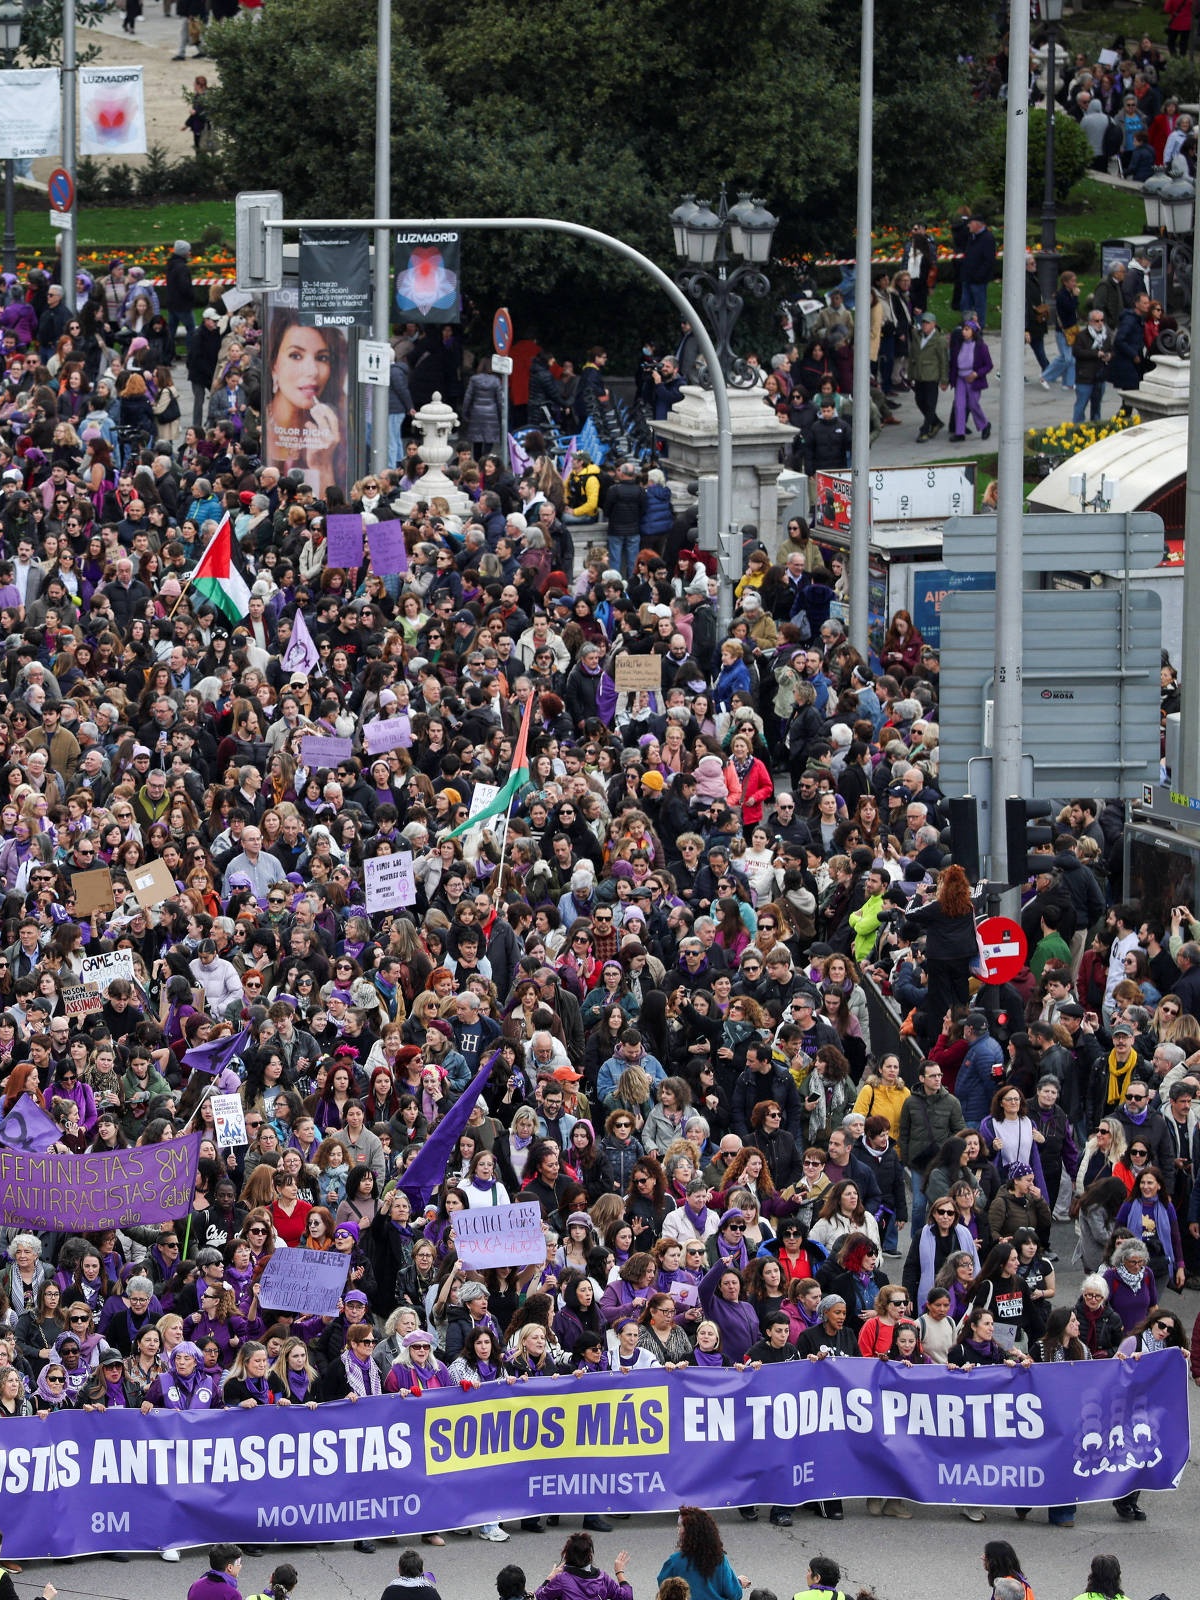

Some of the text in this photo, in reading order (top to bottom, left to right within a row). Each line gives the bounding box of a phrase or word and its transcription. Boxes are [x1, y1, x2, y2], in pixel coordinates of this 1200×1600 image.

[82, 74, 139, 84] LUZMADRID
[397, 232, 459, 244] LUZMADRID
[324, 316, 355, 325] MADRID
[82, 953, 114, 972] GAME
[71, 986, 86, 996] SON
[65, 996, 103, 1014] ASESINATOS
[0, 1145, 190, 1185] FEMINISTAS 8M
[2, 1181, 157, 1214] ANTIRRACISTAS
[3, 1208, 25, 1226] Nos
[53, 1215, 65, 1231] la
[98, 1216, 115, 1229] en
[119, 1208, 142, 1225] ello
[457, 1235, 542, 1255] EDUCA HIJOS
[90, 1422, 412, 1484] ANTIFASCISTAS
[429, 1407, 565, 1463] SOMOS
[576, 1393, 664, 1446] MÁS
[683, 1396, 736, 1442] EN
[746, 1387, 874, 1440] TODAS
[881, 1392, 1045, 1440] PARTES
[91, 1511, 130, 1534] 8M
[257, 1494, 422, 1528] MOVIMIENTO
[528, 1471, 666, 1498] FEMINISTA
[792, 1461, 815, 1487] DE
[938, 1463, 1046, 1489] MADRID
